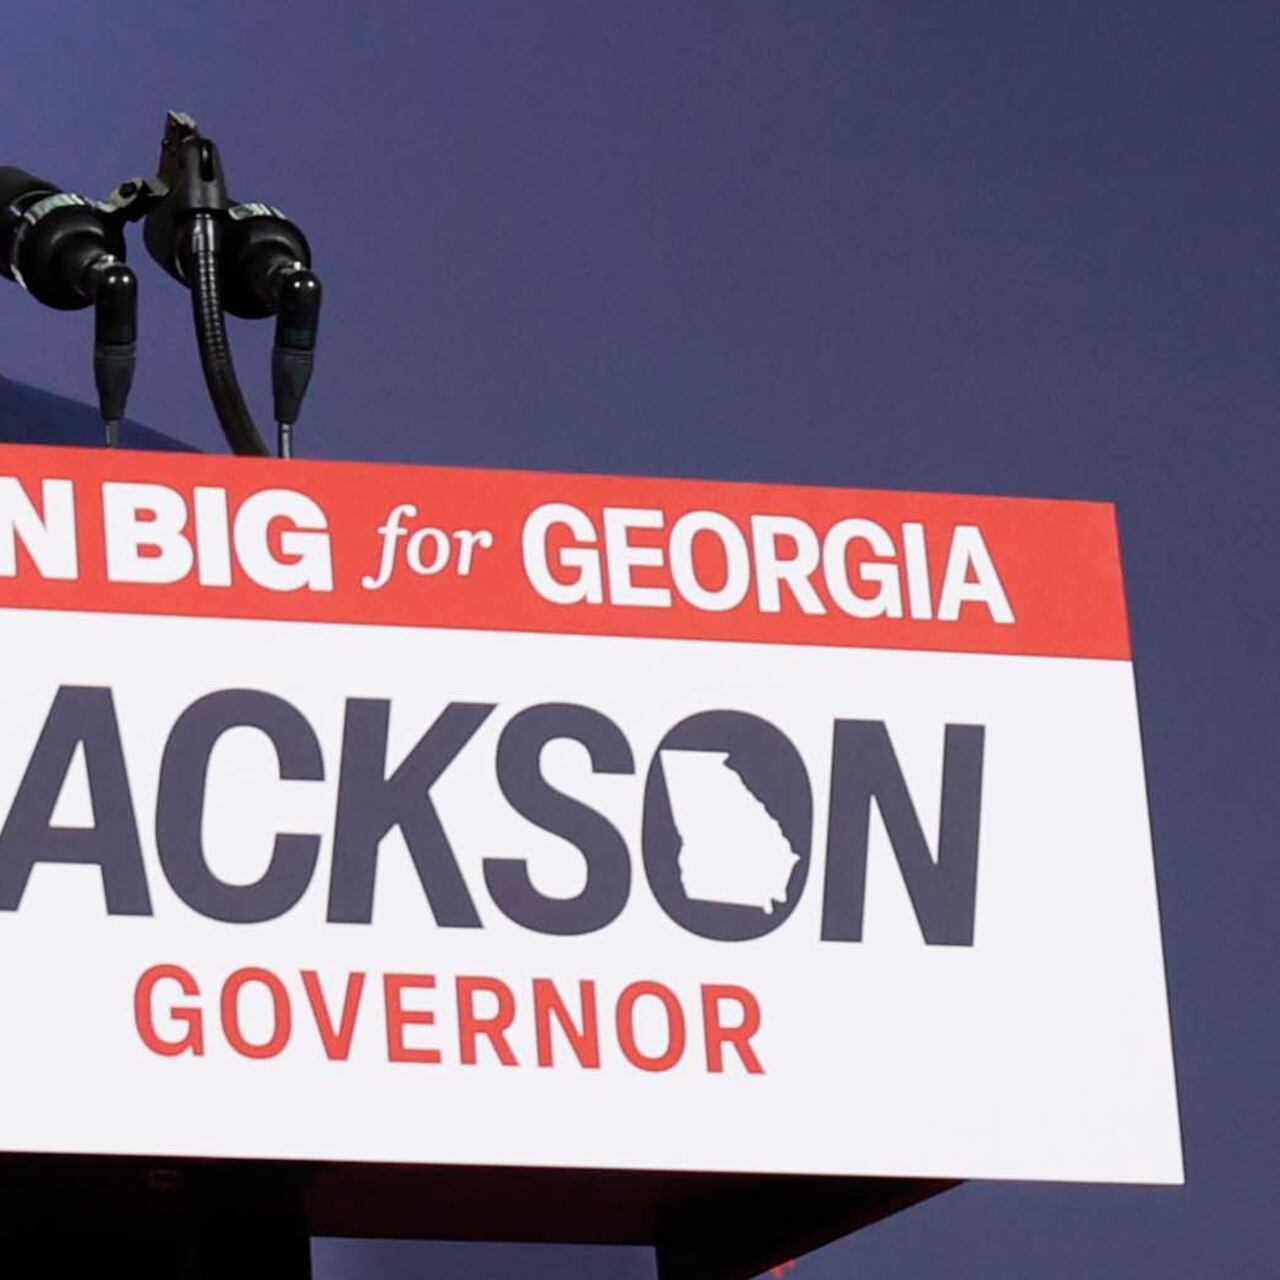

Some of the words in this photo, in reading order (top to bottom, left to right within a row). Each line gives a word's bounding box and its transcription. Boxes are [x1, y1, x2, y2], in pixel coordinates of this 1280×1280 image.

[101, 481, 334, 593] BIG
[361, 503, 493, 590] for
[522, 503, 1016, 625] GEORGIA
[135, 964, 763, 1074] GOVERNOR
